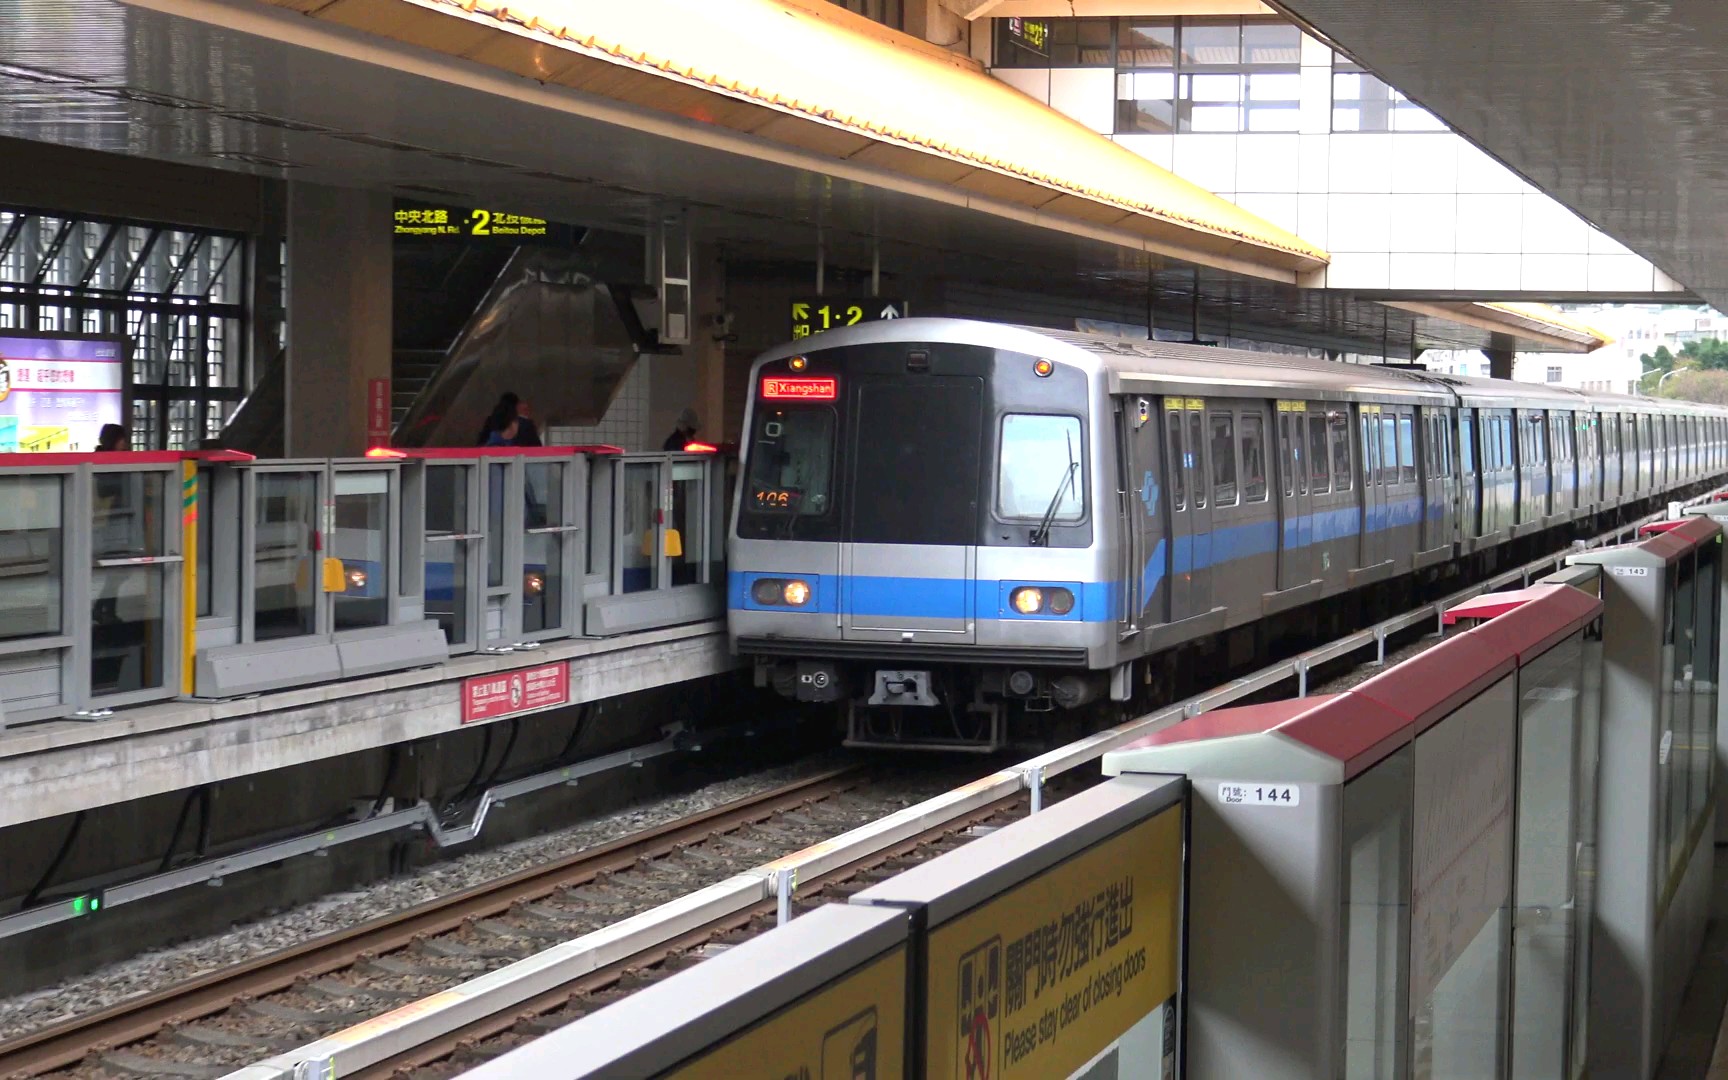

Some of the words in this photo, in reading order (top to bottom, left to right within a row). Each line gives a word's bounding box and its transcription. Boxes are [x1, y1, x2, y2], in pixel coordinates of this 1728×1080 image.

[394, 210, 448, 224] 中央北路
[394, 226, 437, 235] Zhongyang
[448, 226, 460, 234] Rd.
[492, 227, 520, 235] Beitou
[520, 227, 546, 236] Depot
[779, 384, 831, 396] Xiangshan
[1255, 788, 1291, 802] 144
[1005, 876, 1133, 1017] 關門時勿強行進出
[1004, 1023, 1036, 1070] Please
[1039, 1005, 1058, 1045] stay
[1059, 992, 1082, 1028] clear
[1083, 976, 1093, 1012] of
[1093, 966, 1122, 1006] closing
[1123, 947, 1146, 982] doors
